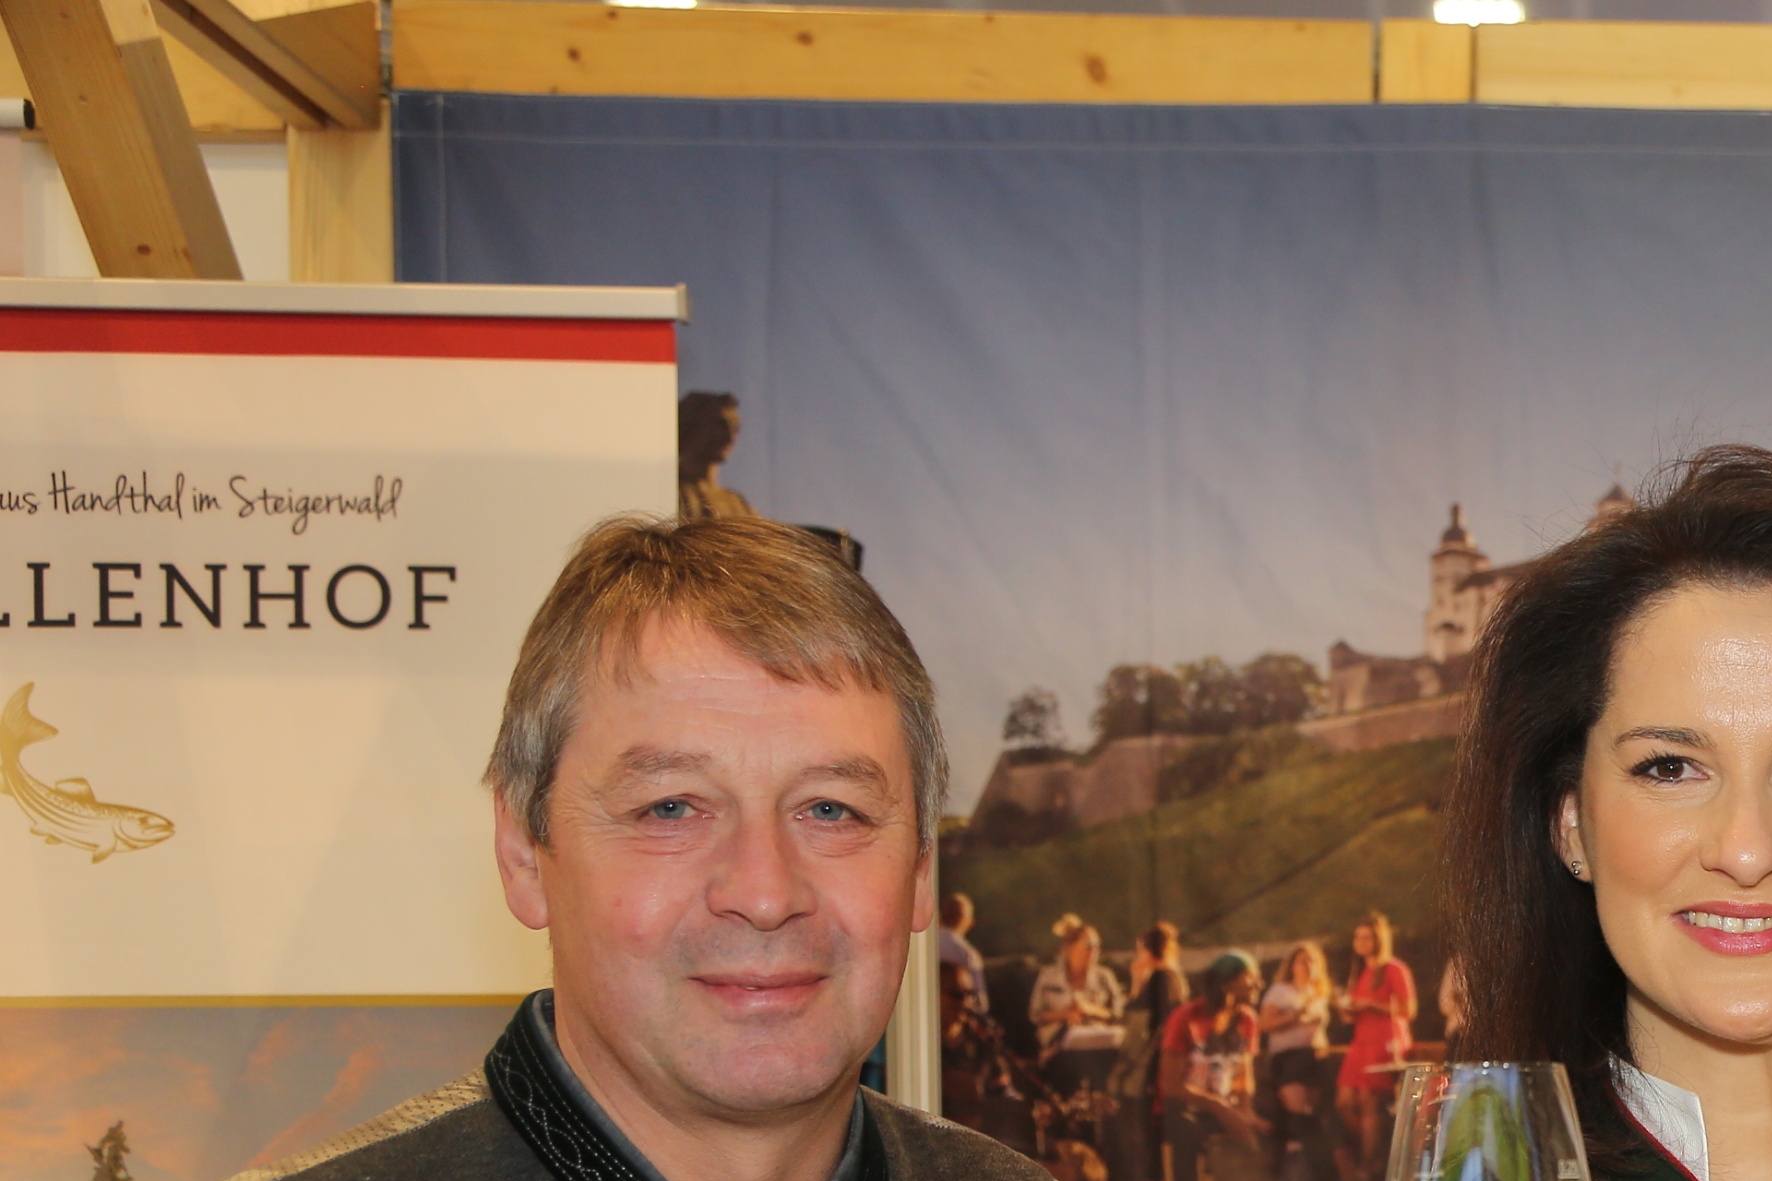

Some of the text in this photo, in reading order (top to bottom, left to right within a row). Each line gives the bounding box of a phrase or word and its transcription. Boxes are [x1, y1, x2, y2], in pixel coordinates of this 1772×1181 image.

[48, 470, 185, 520] Handthal
[191, 486, 222, 514] im
[229, 474, 403, 536] Steigerwald
